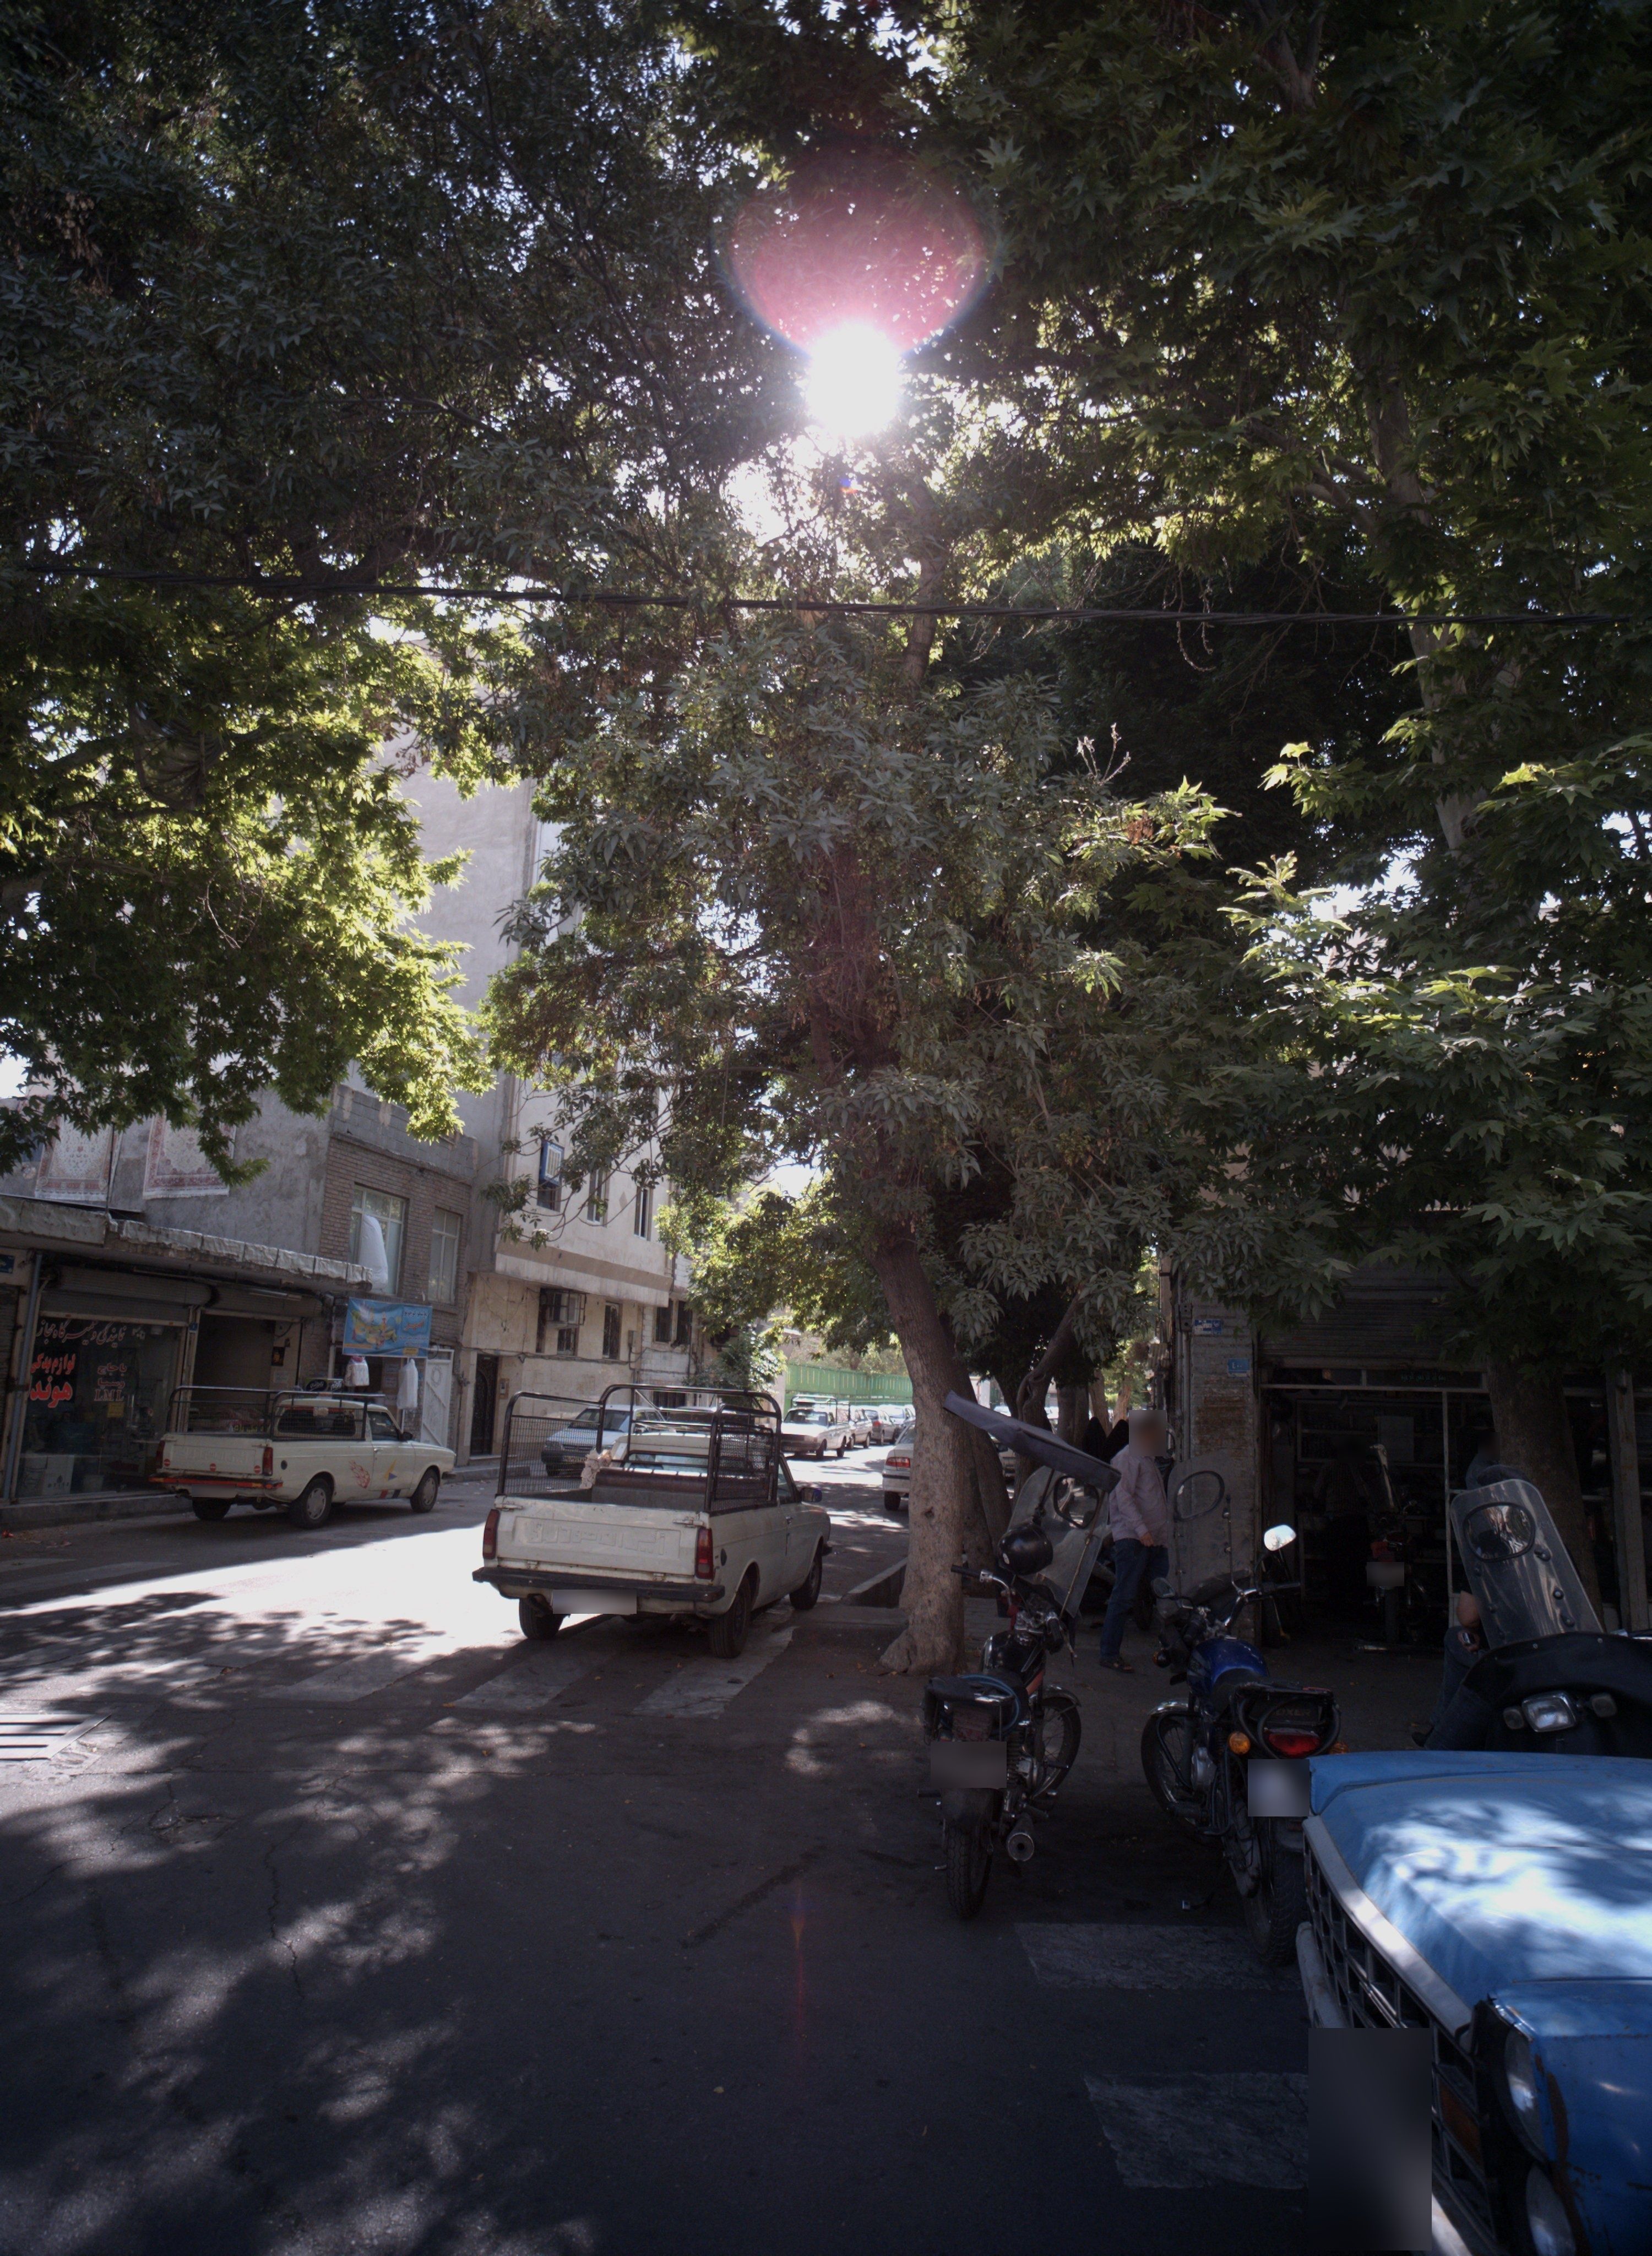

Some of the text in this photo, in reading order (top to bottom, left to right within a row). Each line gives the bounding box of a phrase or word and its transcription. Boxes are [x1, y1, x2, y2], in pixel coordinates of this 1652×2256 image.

[35, 1319, 56, 1344] مجاز
[52, 1319, 97, 1346] عمیرگاه
[30, 1352, 76, 1375] لوازم یدکی
[30, 1375, 73, 1408] هوند
[94, 1389, 124, 1402] LML
